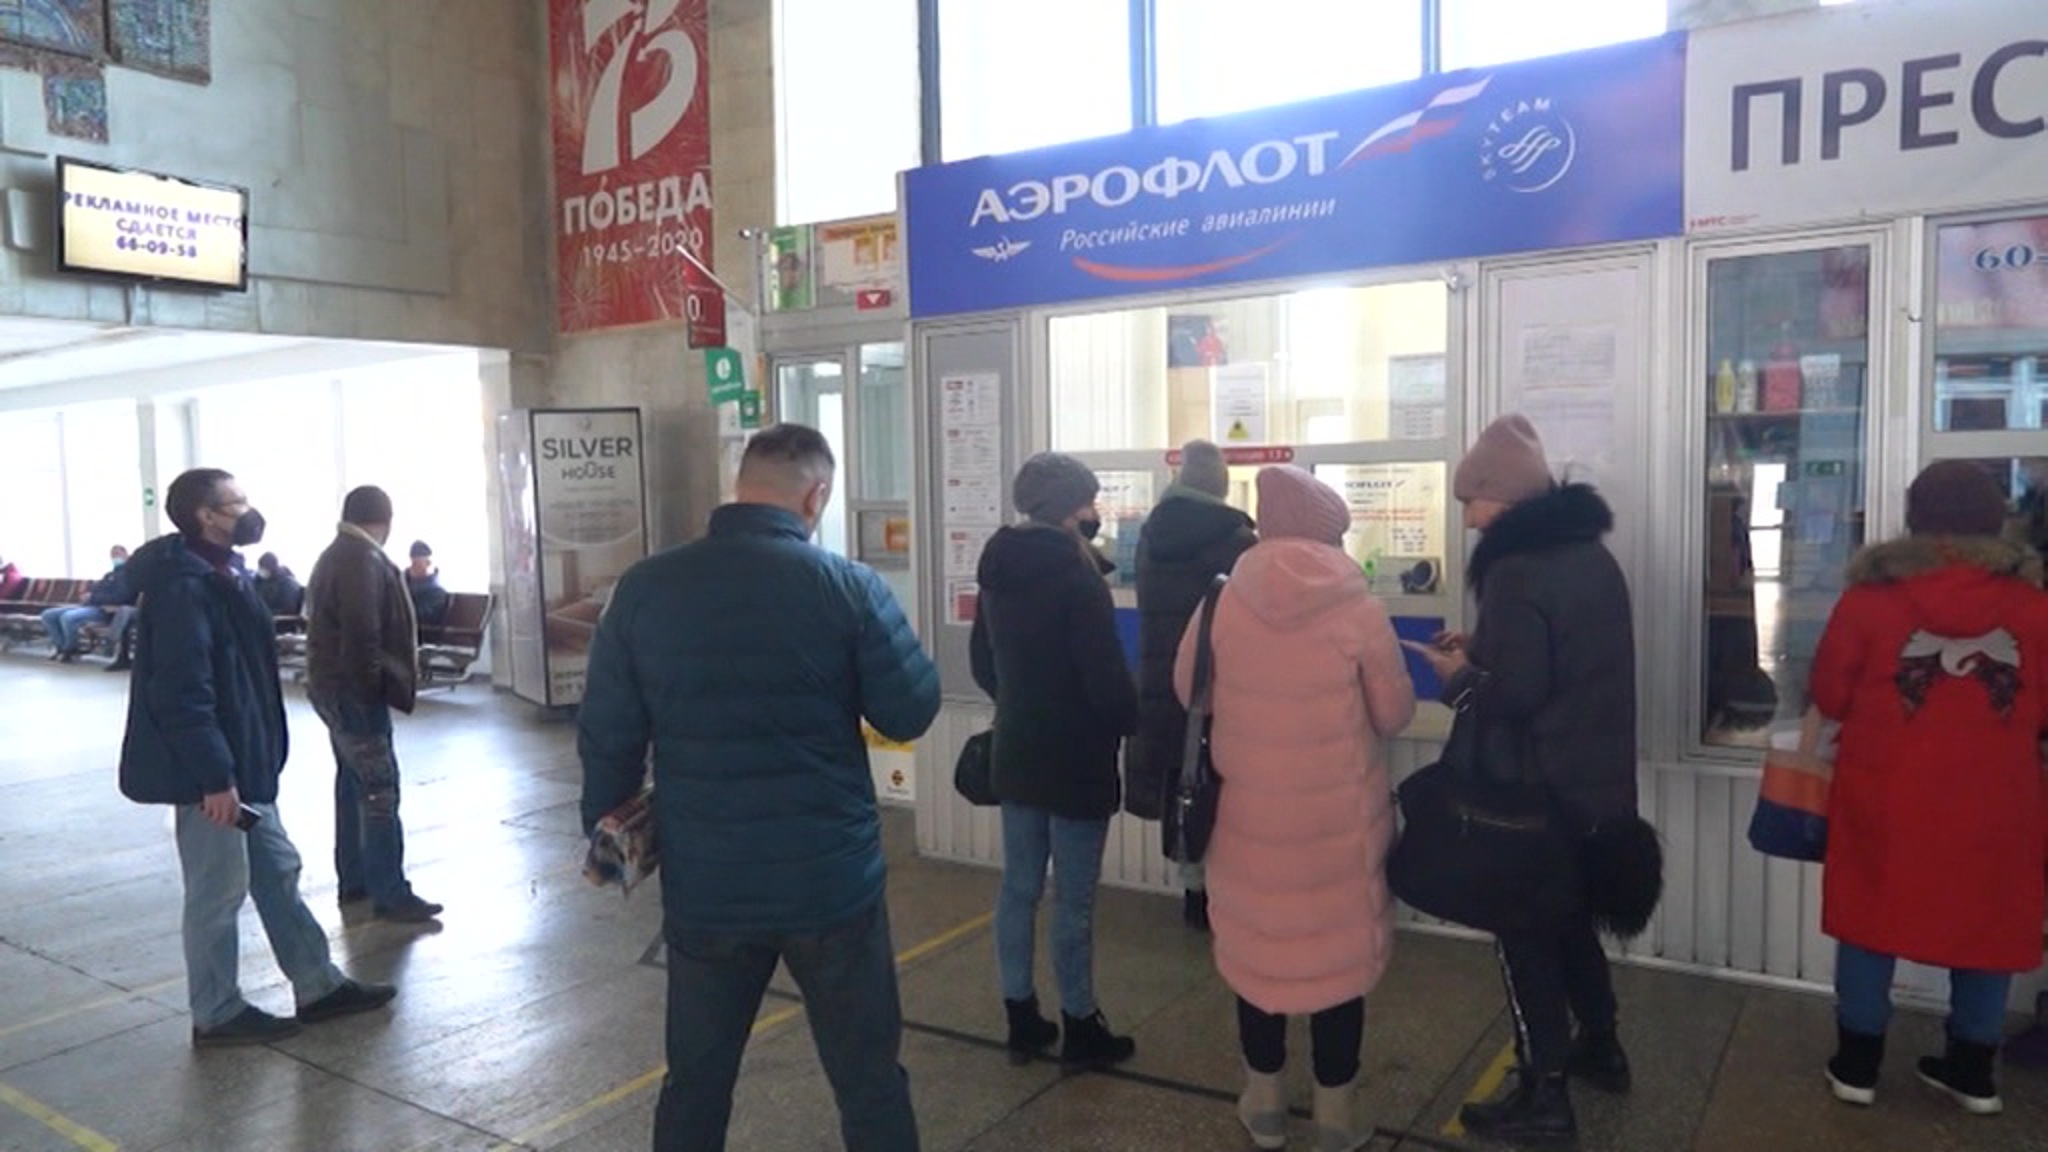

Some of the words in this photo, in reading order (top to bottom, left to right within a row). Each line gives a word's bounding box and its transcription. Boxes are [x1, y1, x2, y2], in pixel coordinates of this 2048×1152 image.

[1731, 40, 2048, 173] ПРЕС
[1482, 97, 1551, 182] SKYTEAM
[564, 172, 712, 236] ПОБЕДА
[969, 131, 1339, 227] АЭРОФЛОТ
[115, 218, 197, 241] СДАЕТСЯ
[1059, 216, 1190, 252] Российские
[1201, 199, 1336, 234] авиалинии
[541, 436, 634, 460] SILVER
[561, 461, 617, 480] HOUSE
